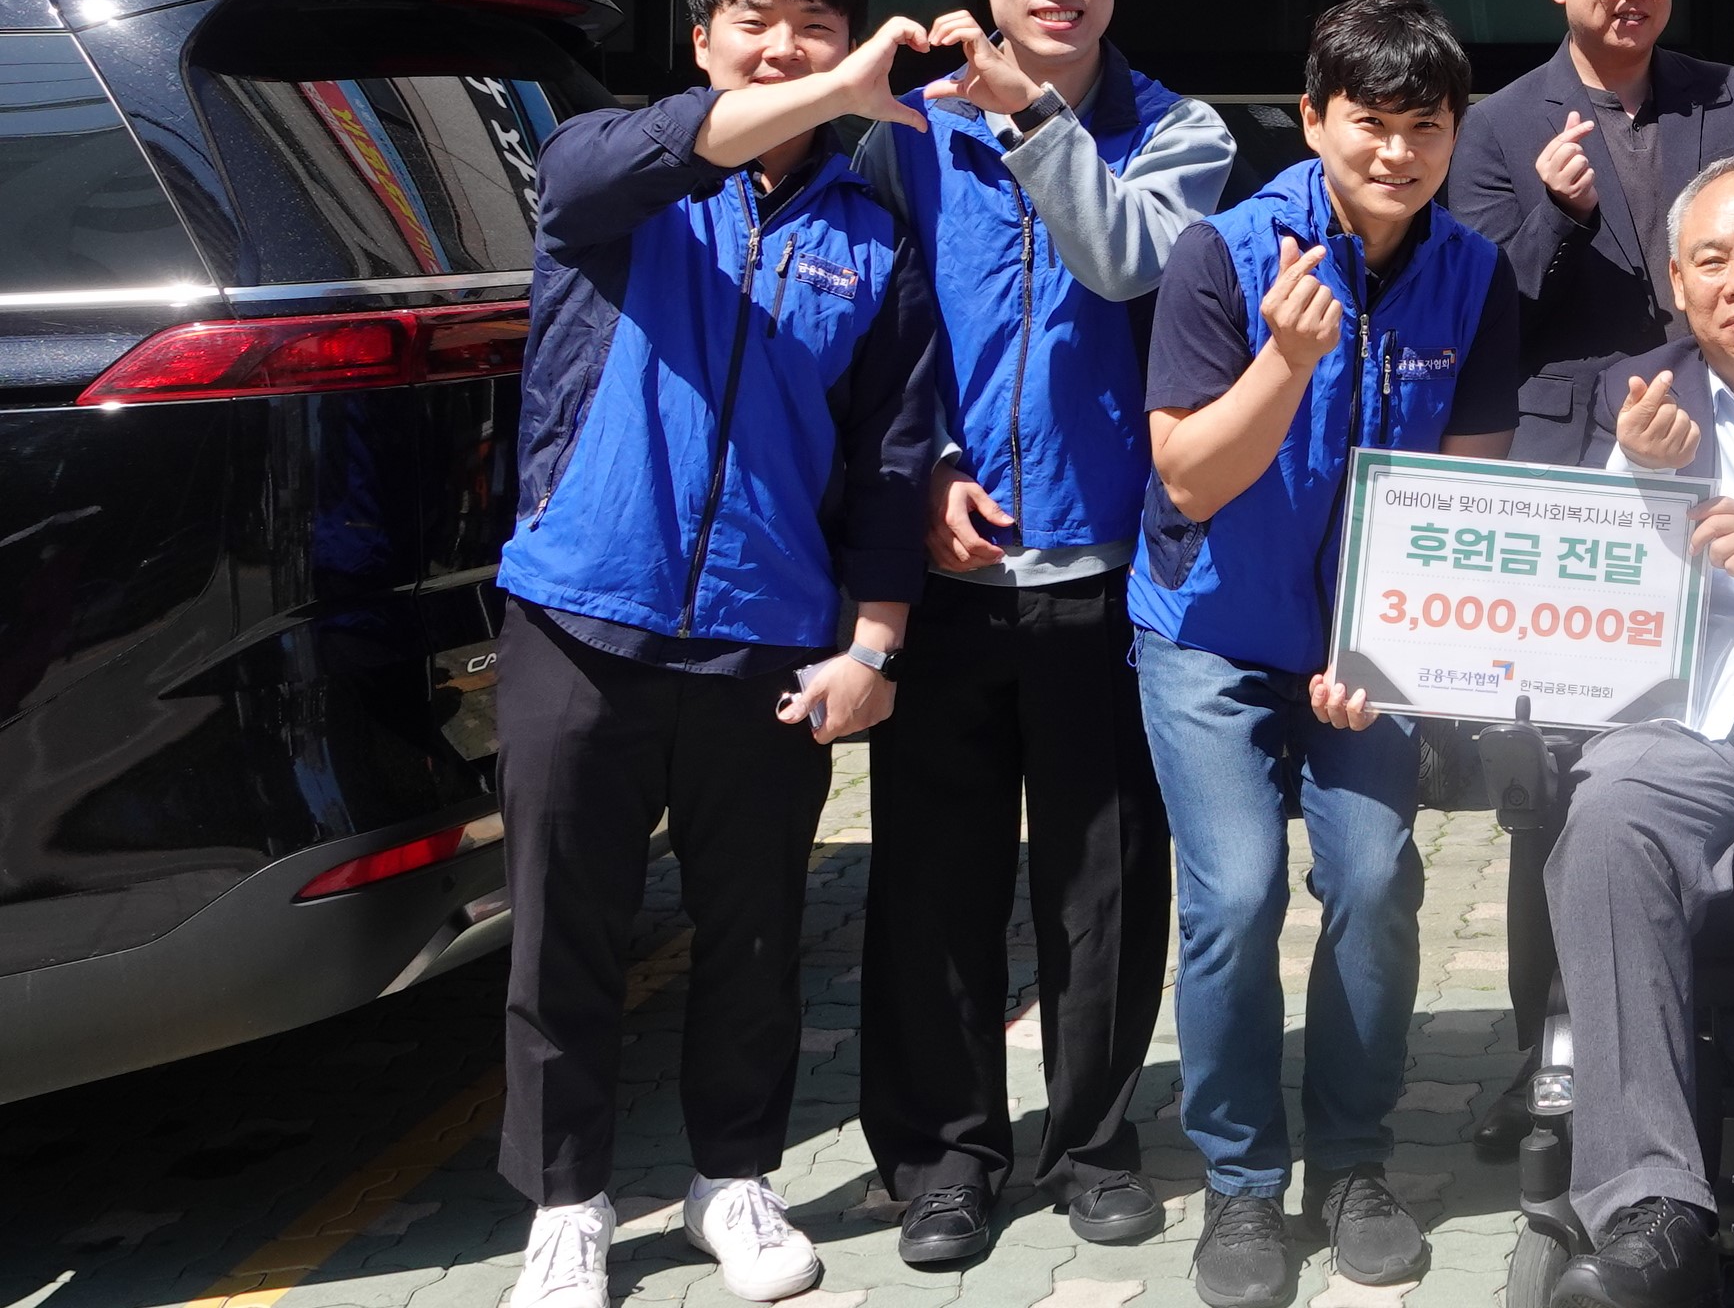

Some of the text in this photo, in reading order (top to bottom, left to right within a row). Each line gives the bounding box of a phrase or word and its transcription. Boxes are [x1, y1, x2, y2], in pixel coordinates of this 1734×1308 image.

[1398, 358, 1450, 372] 금융투자협회
[1385, 489, 1672, 531] 어버이날 맞이 지역사회복지시설 위문
[1406, 522, 1648, 585] 후원금 전달
[1379, 589, 1665, 647] 3,000,000원
[1418, 667, 1500, 689] 금융투자협회
[1519, 678, 1614, 699] 한국금융투자협회
